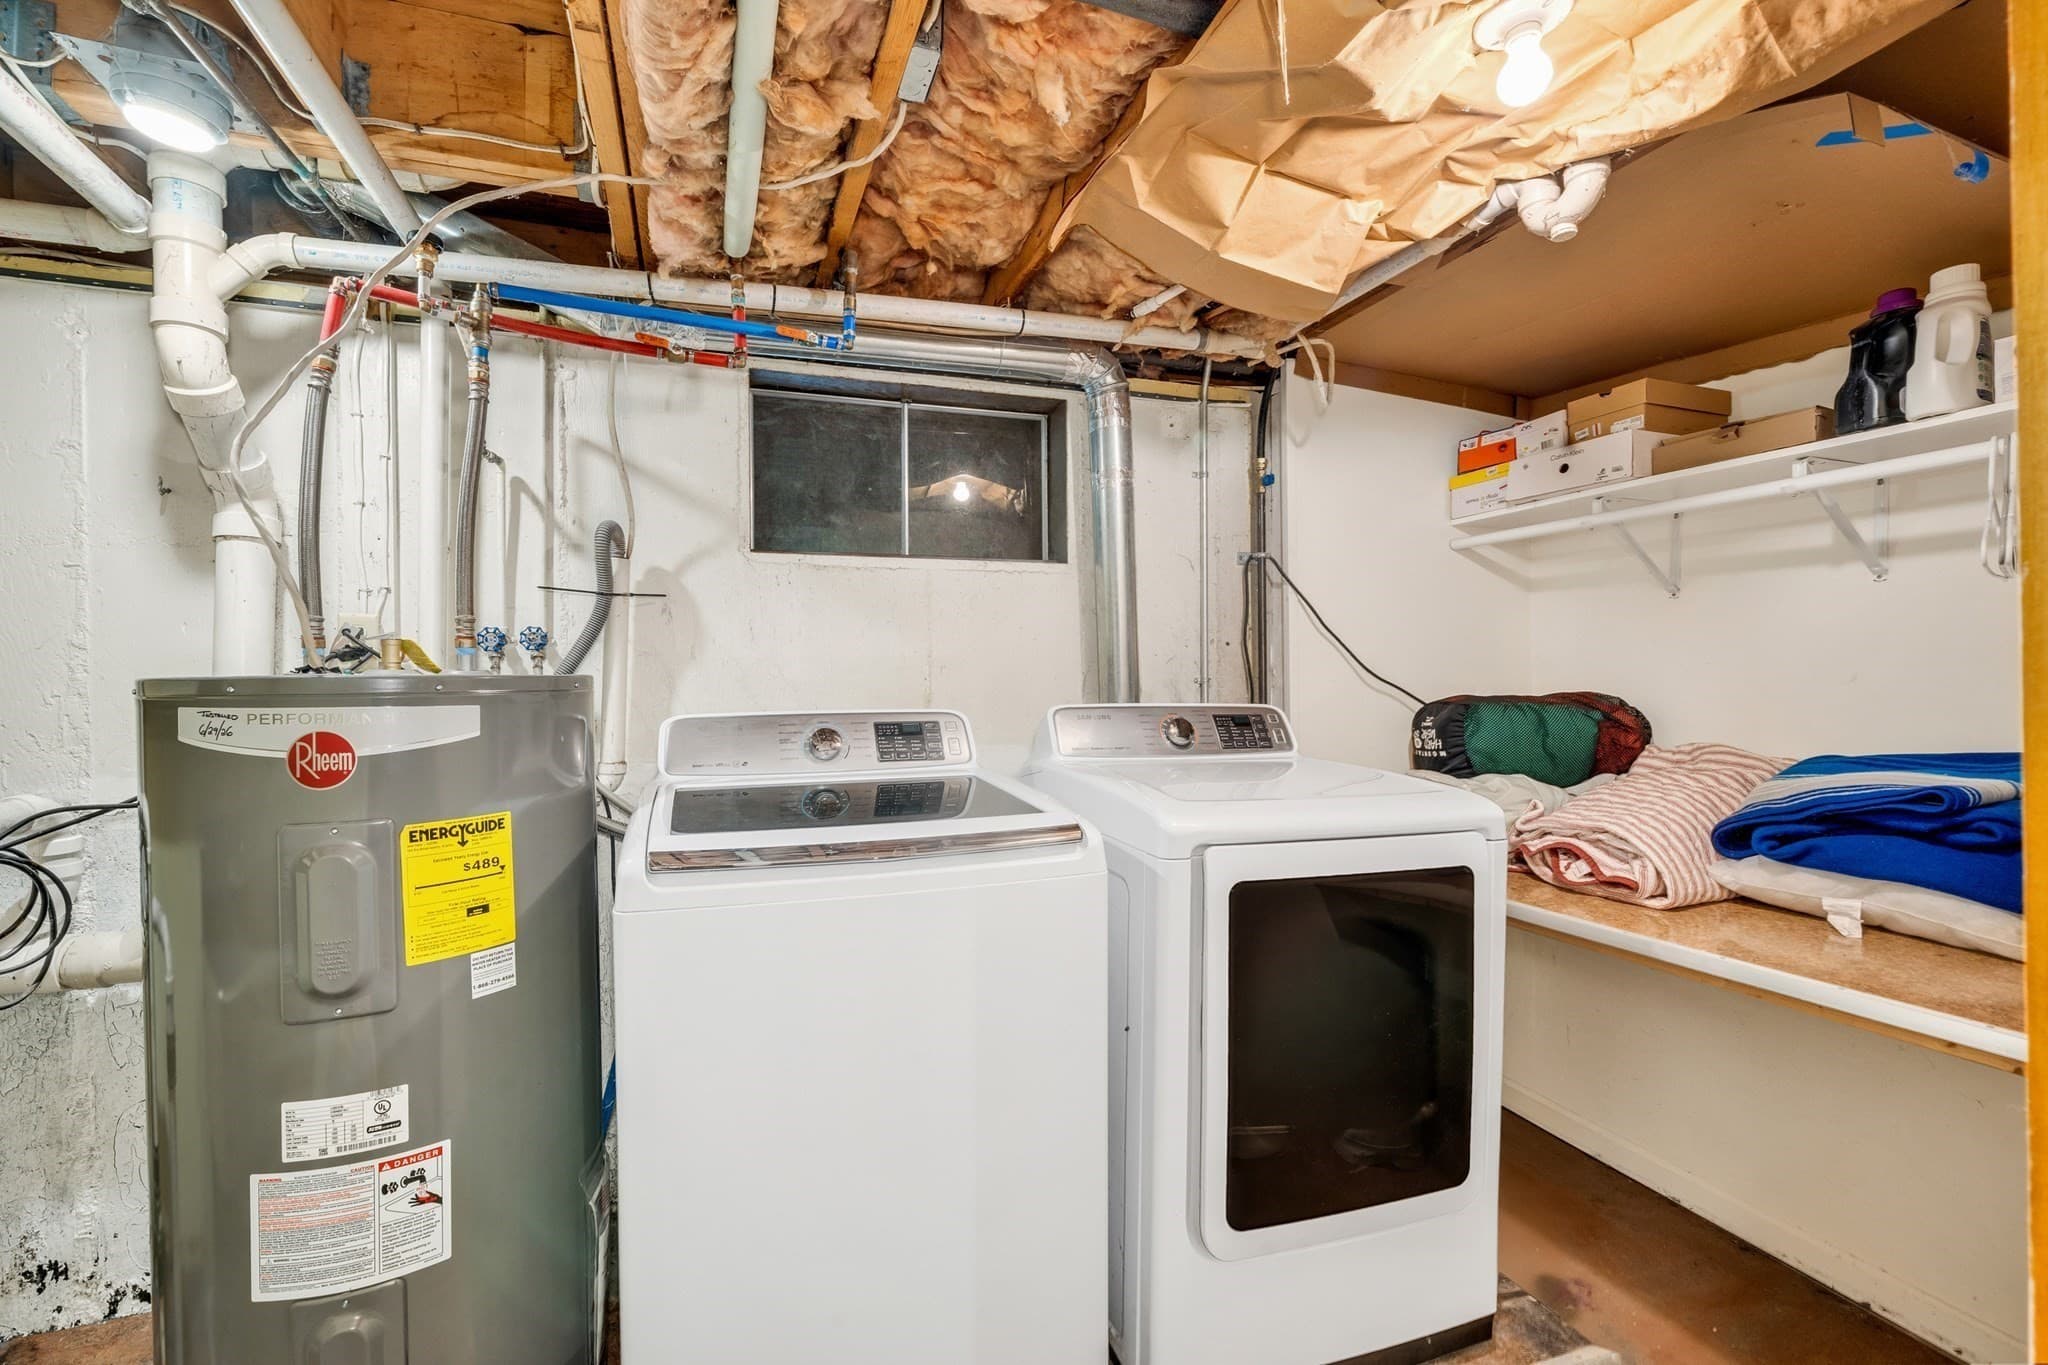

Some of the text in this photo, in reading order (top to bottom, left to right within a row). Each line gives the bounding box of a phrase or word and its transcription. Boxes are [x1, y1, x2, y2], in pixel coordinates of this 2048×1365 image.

[296, 732, 353, 780] Rheem
[409, 818, 506, 844] ENERGYGUIDE
[463, 856, 501, 872] $489
[393, 1149, 439, 1167] DANGER
[350, 1164, 375, 1173] CAUTION
